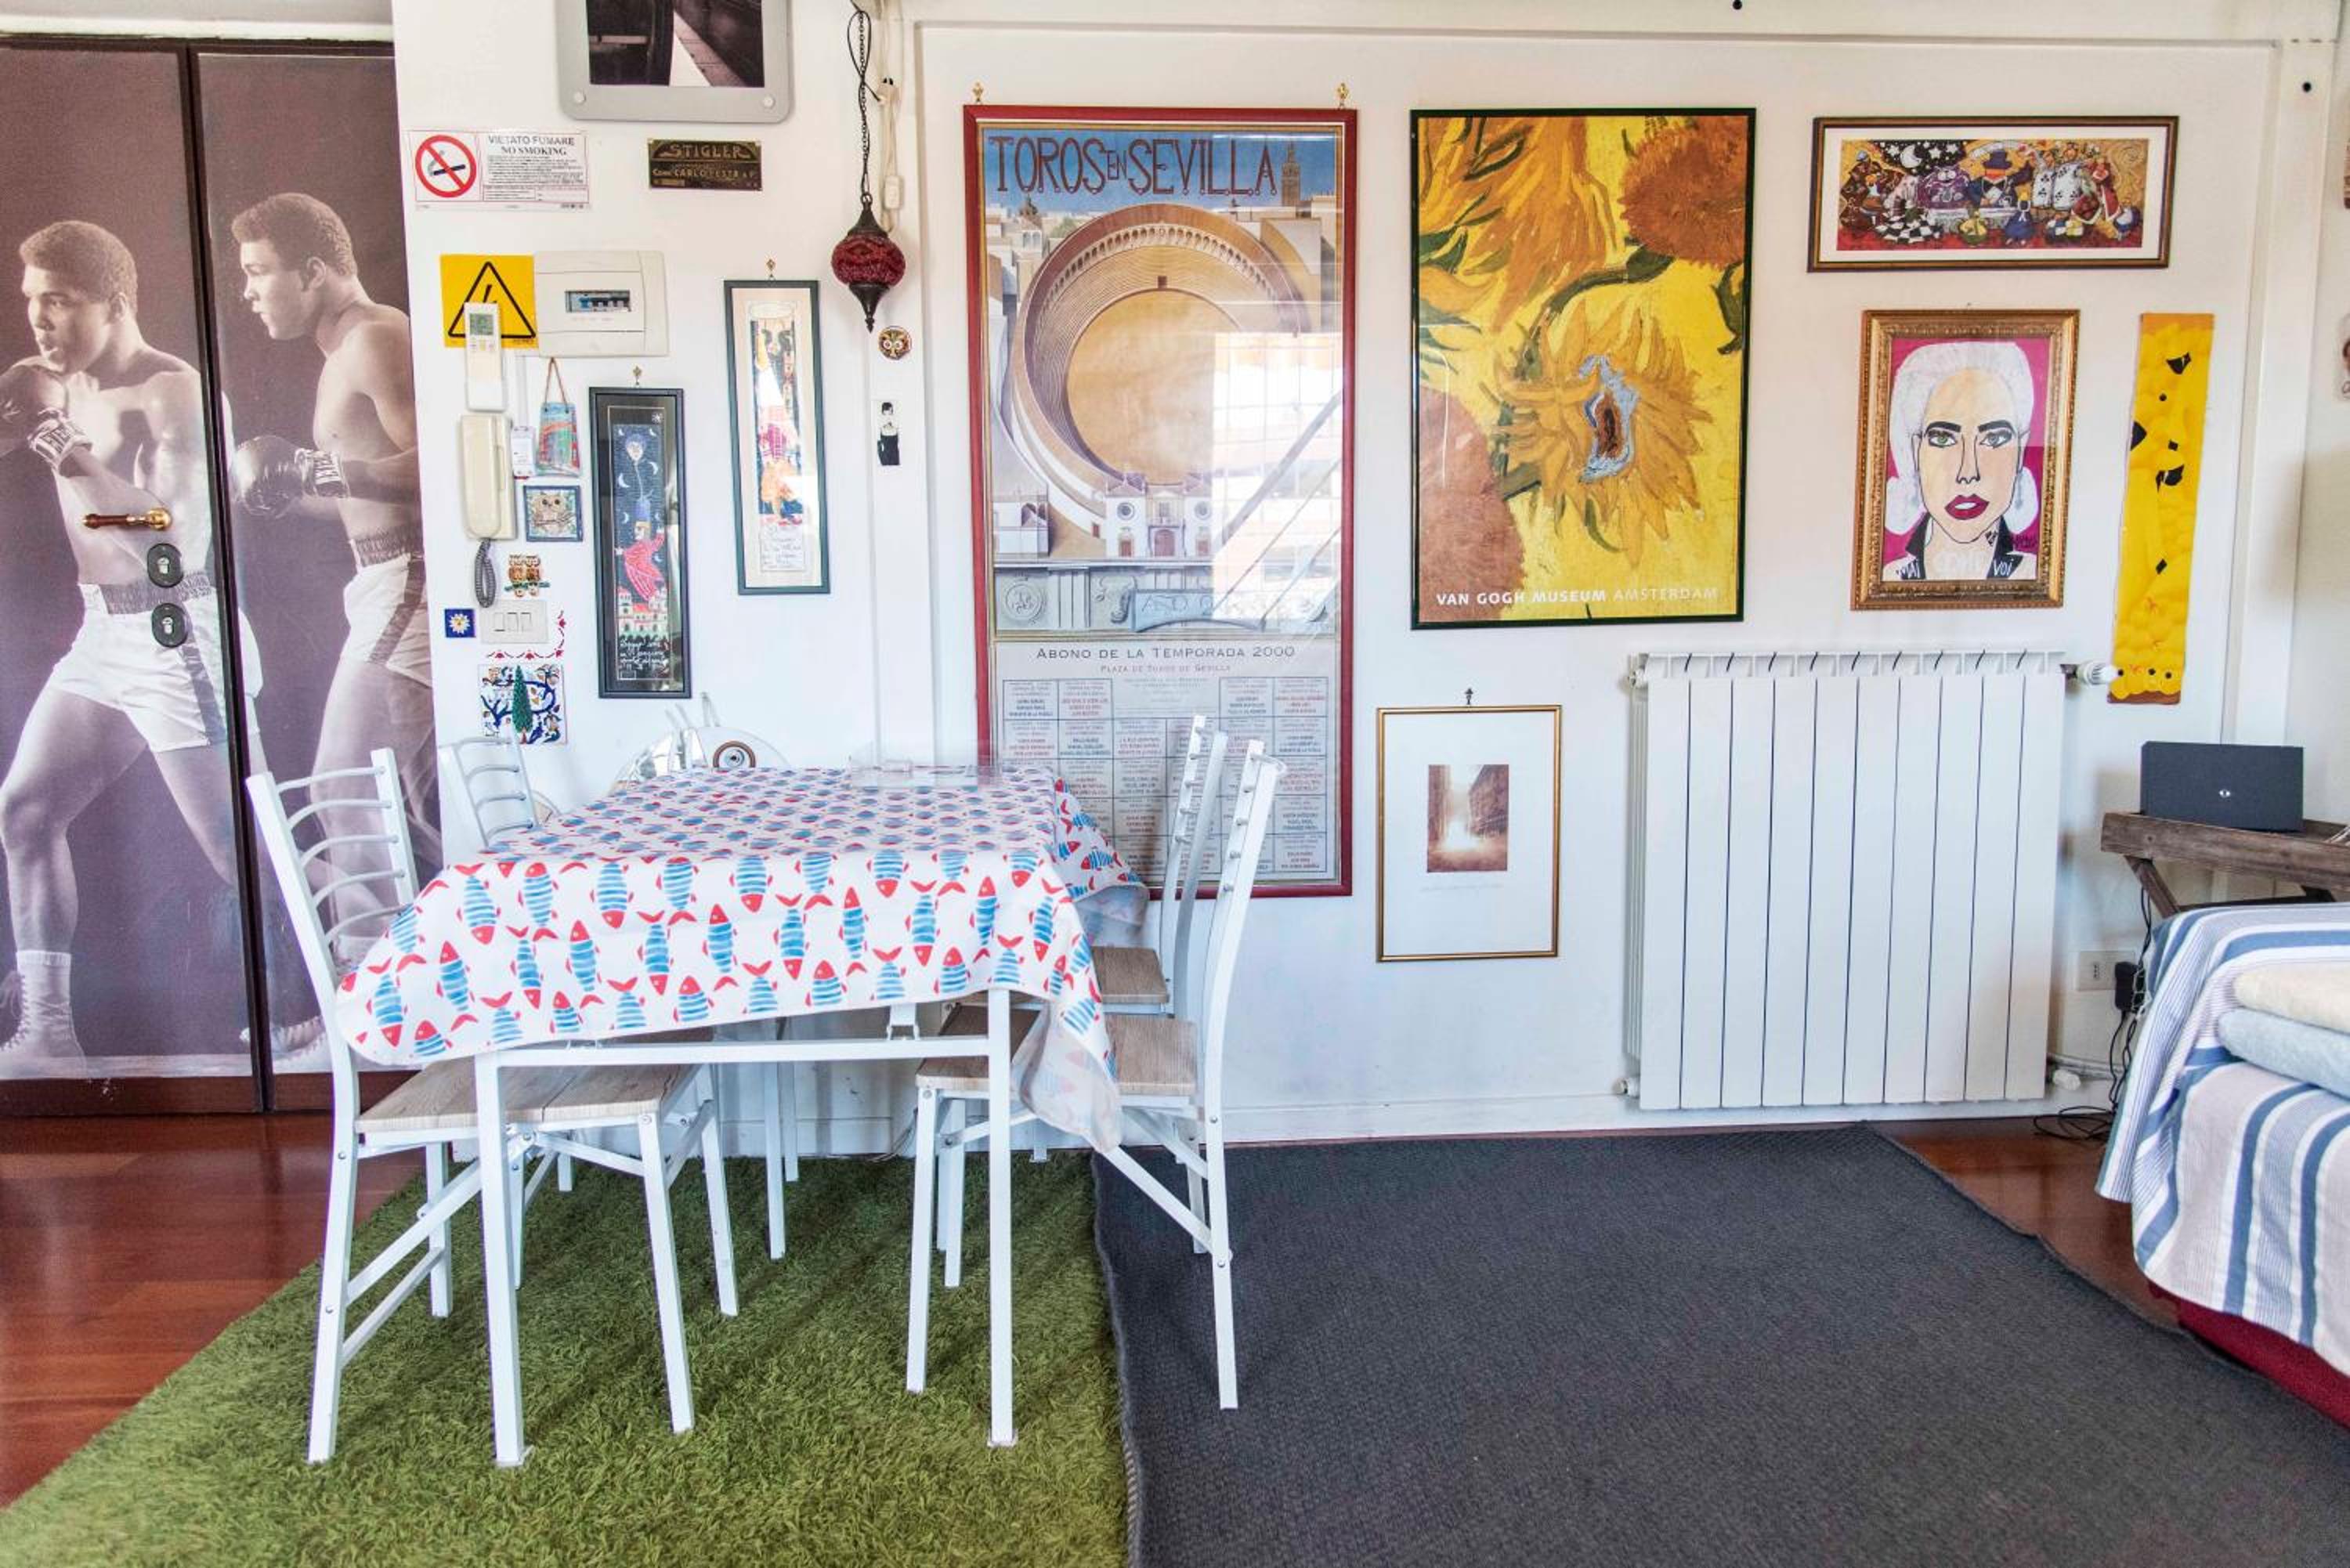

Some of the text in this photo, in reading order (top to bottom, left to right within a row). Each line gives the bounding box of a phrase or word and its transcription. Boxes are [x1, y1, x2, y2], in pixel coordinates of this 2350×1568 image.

[488, 135, 575, 146] VIETATO FUMARE
[501, 146, 567, 156] NO SMOKING
[670, 143, 741, 158] STIGLER
[989, 135, 1278, 197] TOROS EN SEVILLA
[1436, 587, 1719, 606] VAN GOGH MUSEUM AMSTERDAM
[1036, 646, 1295, 659] ABONO DE LA TEMPORADA 2000
